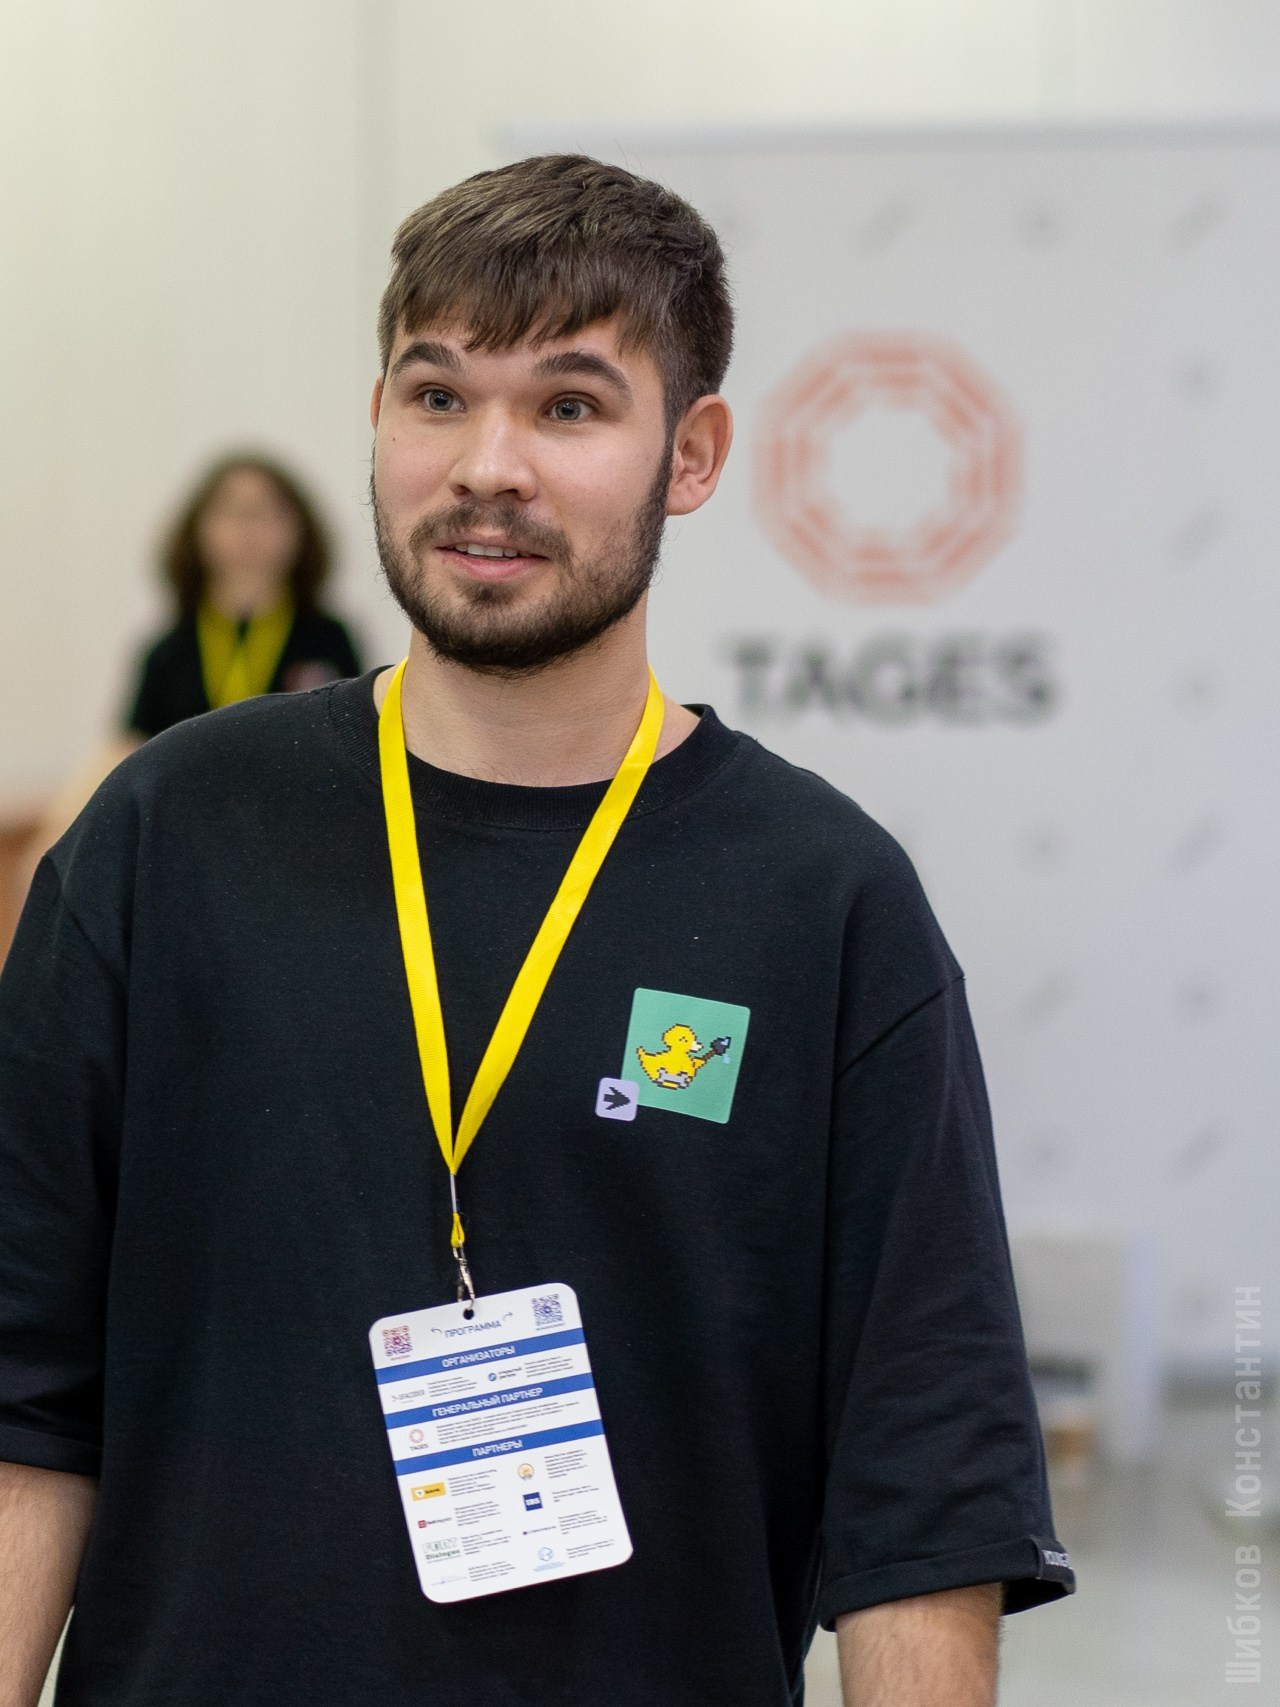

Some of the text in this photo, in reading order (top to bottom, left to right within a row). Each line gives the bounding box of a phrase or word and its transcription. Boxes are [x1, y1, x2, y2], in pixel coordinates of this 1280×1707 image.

[724, 634, 1059, 731] TAGES
[445, 1320, 502, 1339] ПРОГРАММА
[441, 1345, 516, 1368] ОРГАНИЗАТОРЫ
[432, 1395, 501, 1418] ГЕНЕРАЛЬНЫЙ
[500, 1387, 544, 1406] ПАРТНЕР
[472, 1439, 524, 1457] ПАРТНЕРЫ
